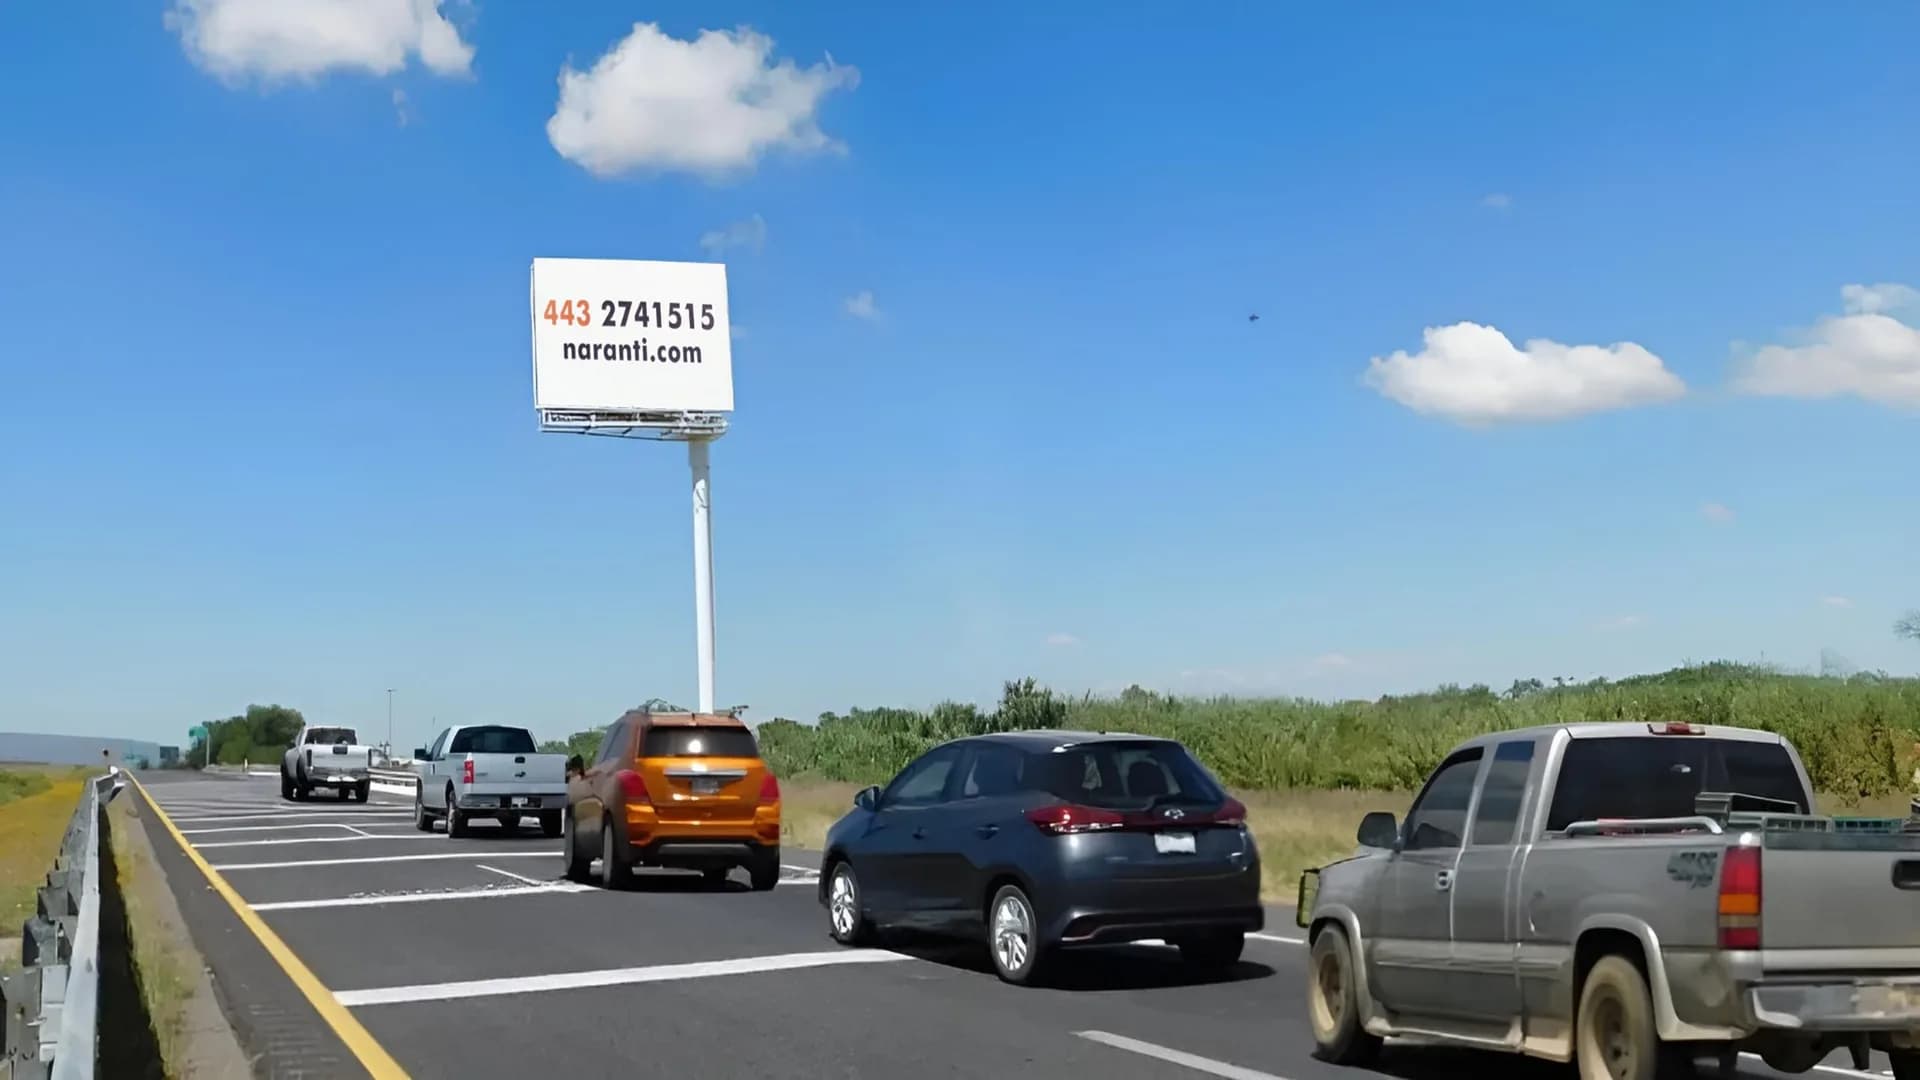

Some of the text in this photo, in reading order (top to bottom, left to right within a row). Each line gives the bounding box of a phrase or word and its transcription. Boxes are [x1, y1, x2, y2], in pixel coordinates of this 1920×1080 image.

[544, 299, 715, 330] 443 2741515
[563, 338, 702, 363] naranti.com
